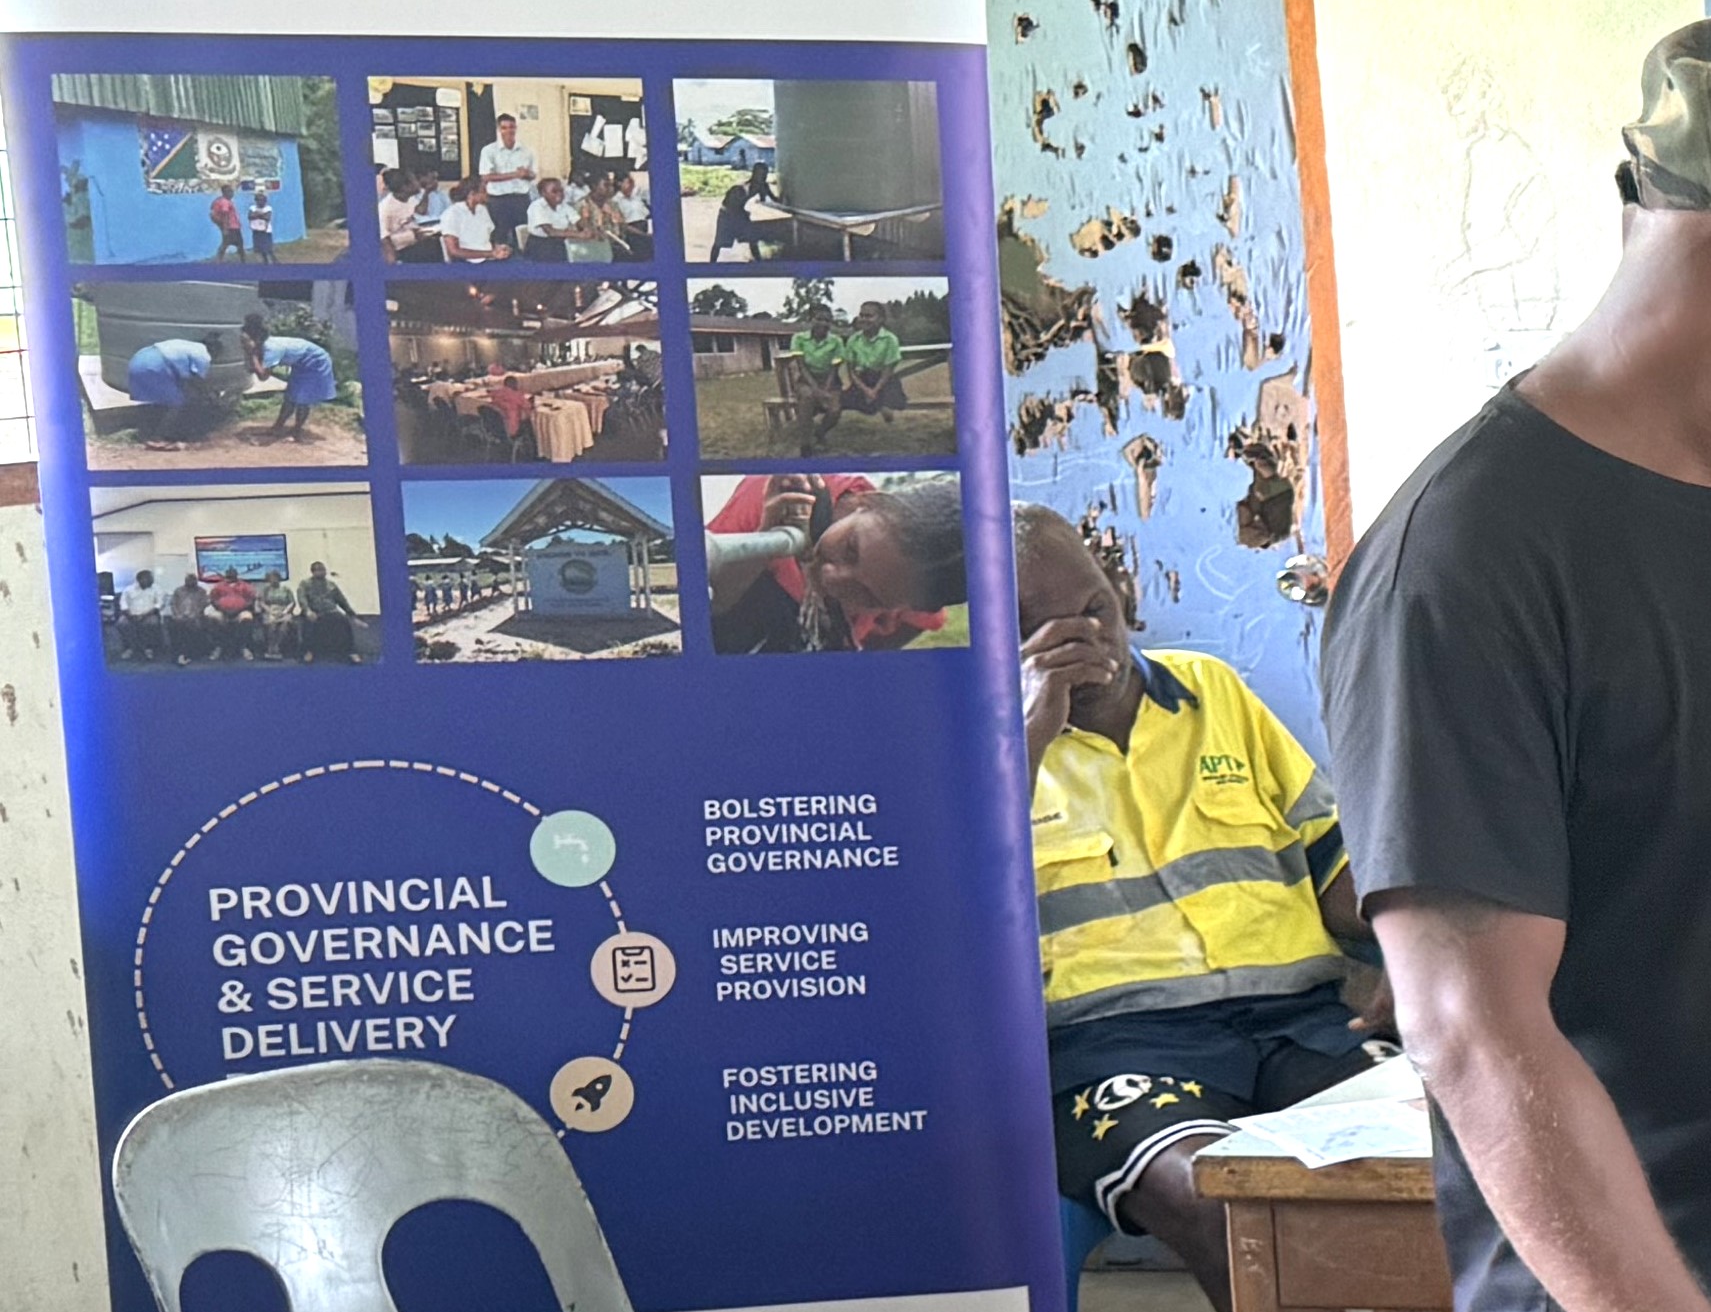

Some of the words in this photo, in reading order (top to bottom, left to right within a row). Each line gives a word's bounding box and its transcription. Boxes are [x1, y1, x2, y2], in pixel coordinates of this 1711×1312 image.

[703, 793, 878, 820] BOLSTERING
[705, 821, 872, 846] PROVINCIAL
[707, 846, 900, 873] GOVERNANCE
[208, 875, 507, 922] PROVINCIAL
[211, 919, 556, 968] GOVERNANCE
[712, 922, 869, 948] IMPROVING
[720, 949, 837, 975] SERVICE
[217, 980, 254, 1015] &
[266, 967, 475, 1012] SERVICE
[716, 975, 867, 1001] PROVISION
[221, 1013, 458, 1060] DELIVERY
[722, 1060, 878, 1088] FOSTERING
[730, 1086, 874, 1115] INCLUSIVE
[726, 1110, 928, 1141] DEVELOPMENT
